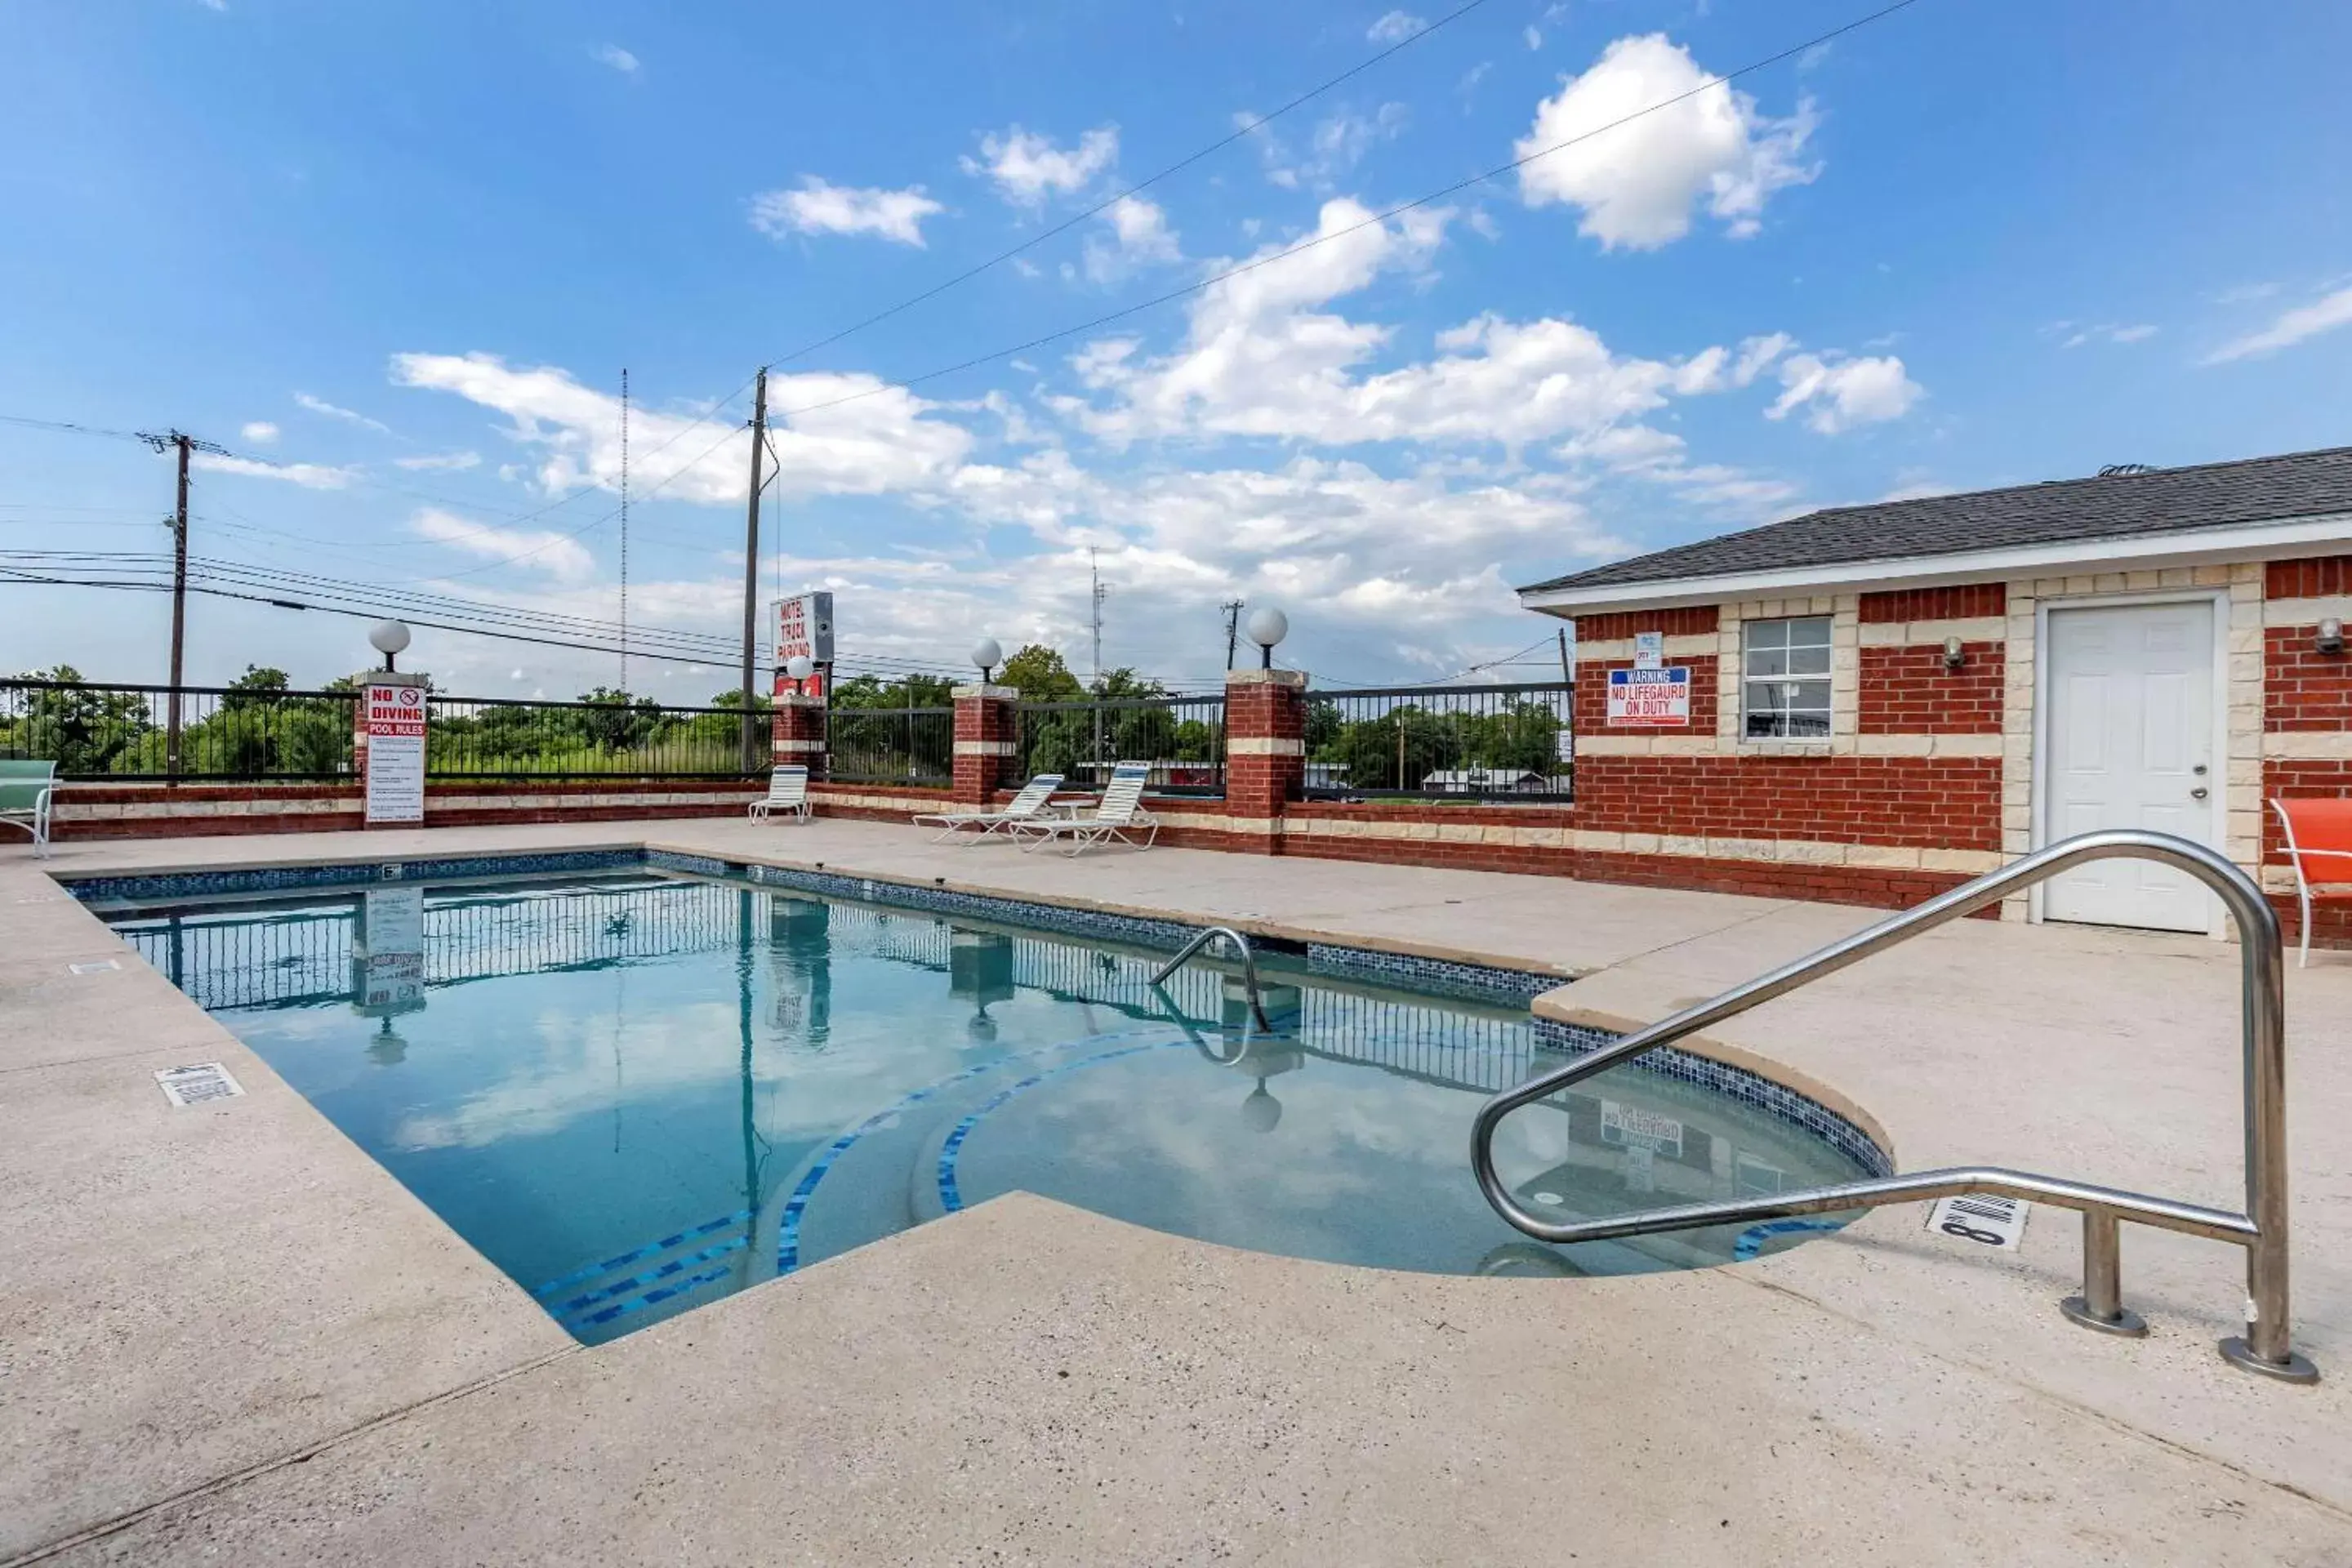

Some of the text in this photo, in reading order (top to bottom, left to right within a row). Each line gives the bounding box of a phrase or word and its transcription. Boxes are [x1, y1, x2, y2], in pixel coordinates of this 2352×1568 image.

[1628, 670, 1670, 684] WARNING
[372, 689, 392, 702] NO
[1612, 685, 1685, 700] NO LIFEGAURD
[372, 707, 422, 720] DIVING
[1626, 701, 1670, 715] ON DUTY
[369, 724, 423, 735] POOL RULES
